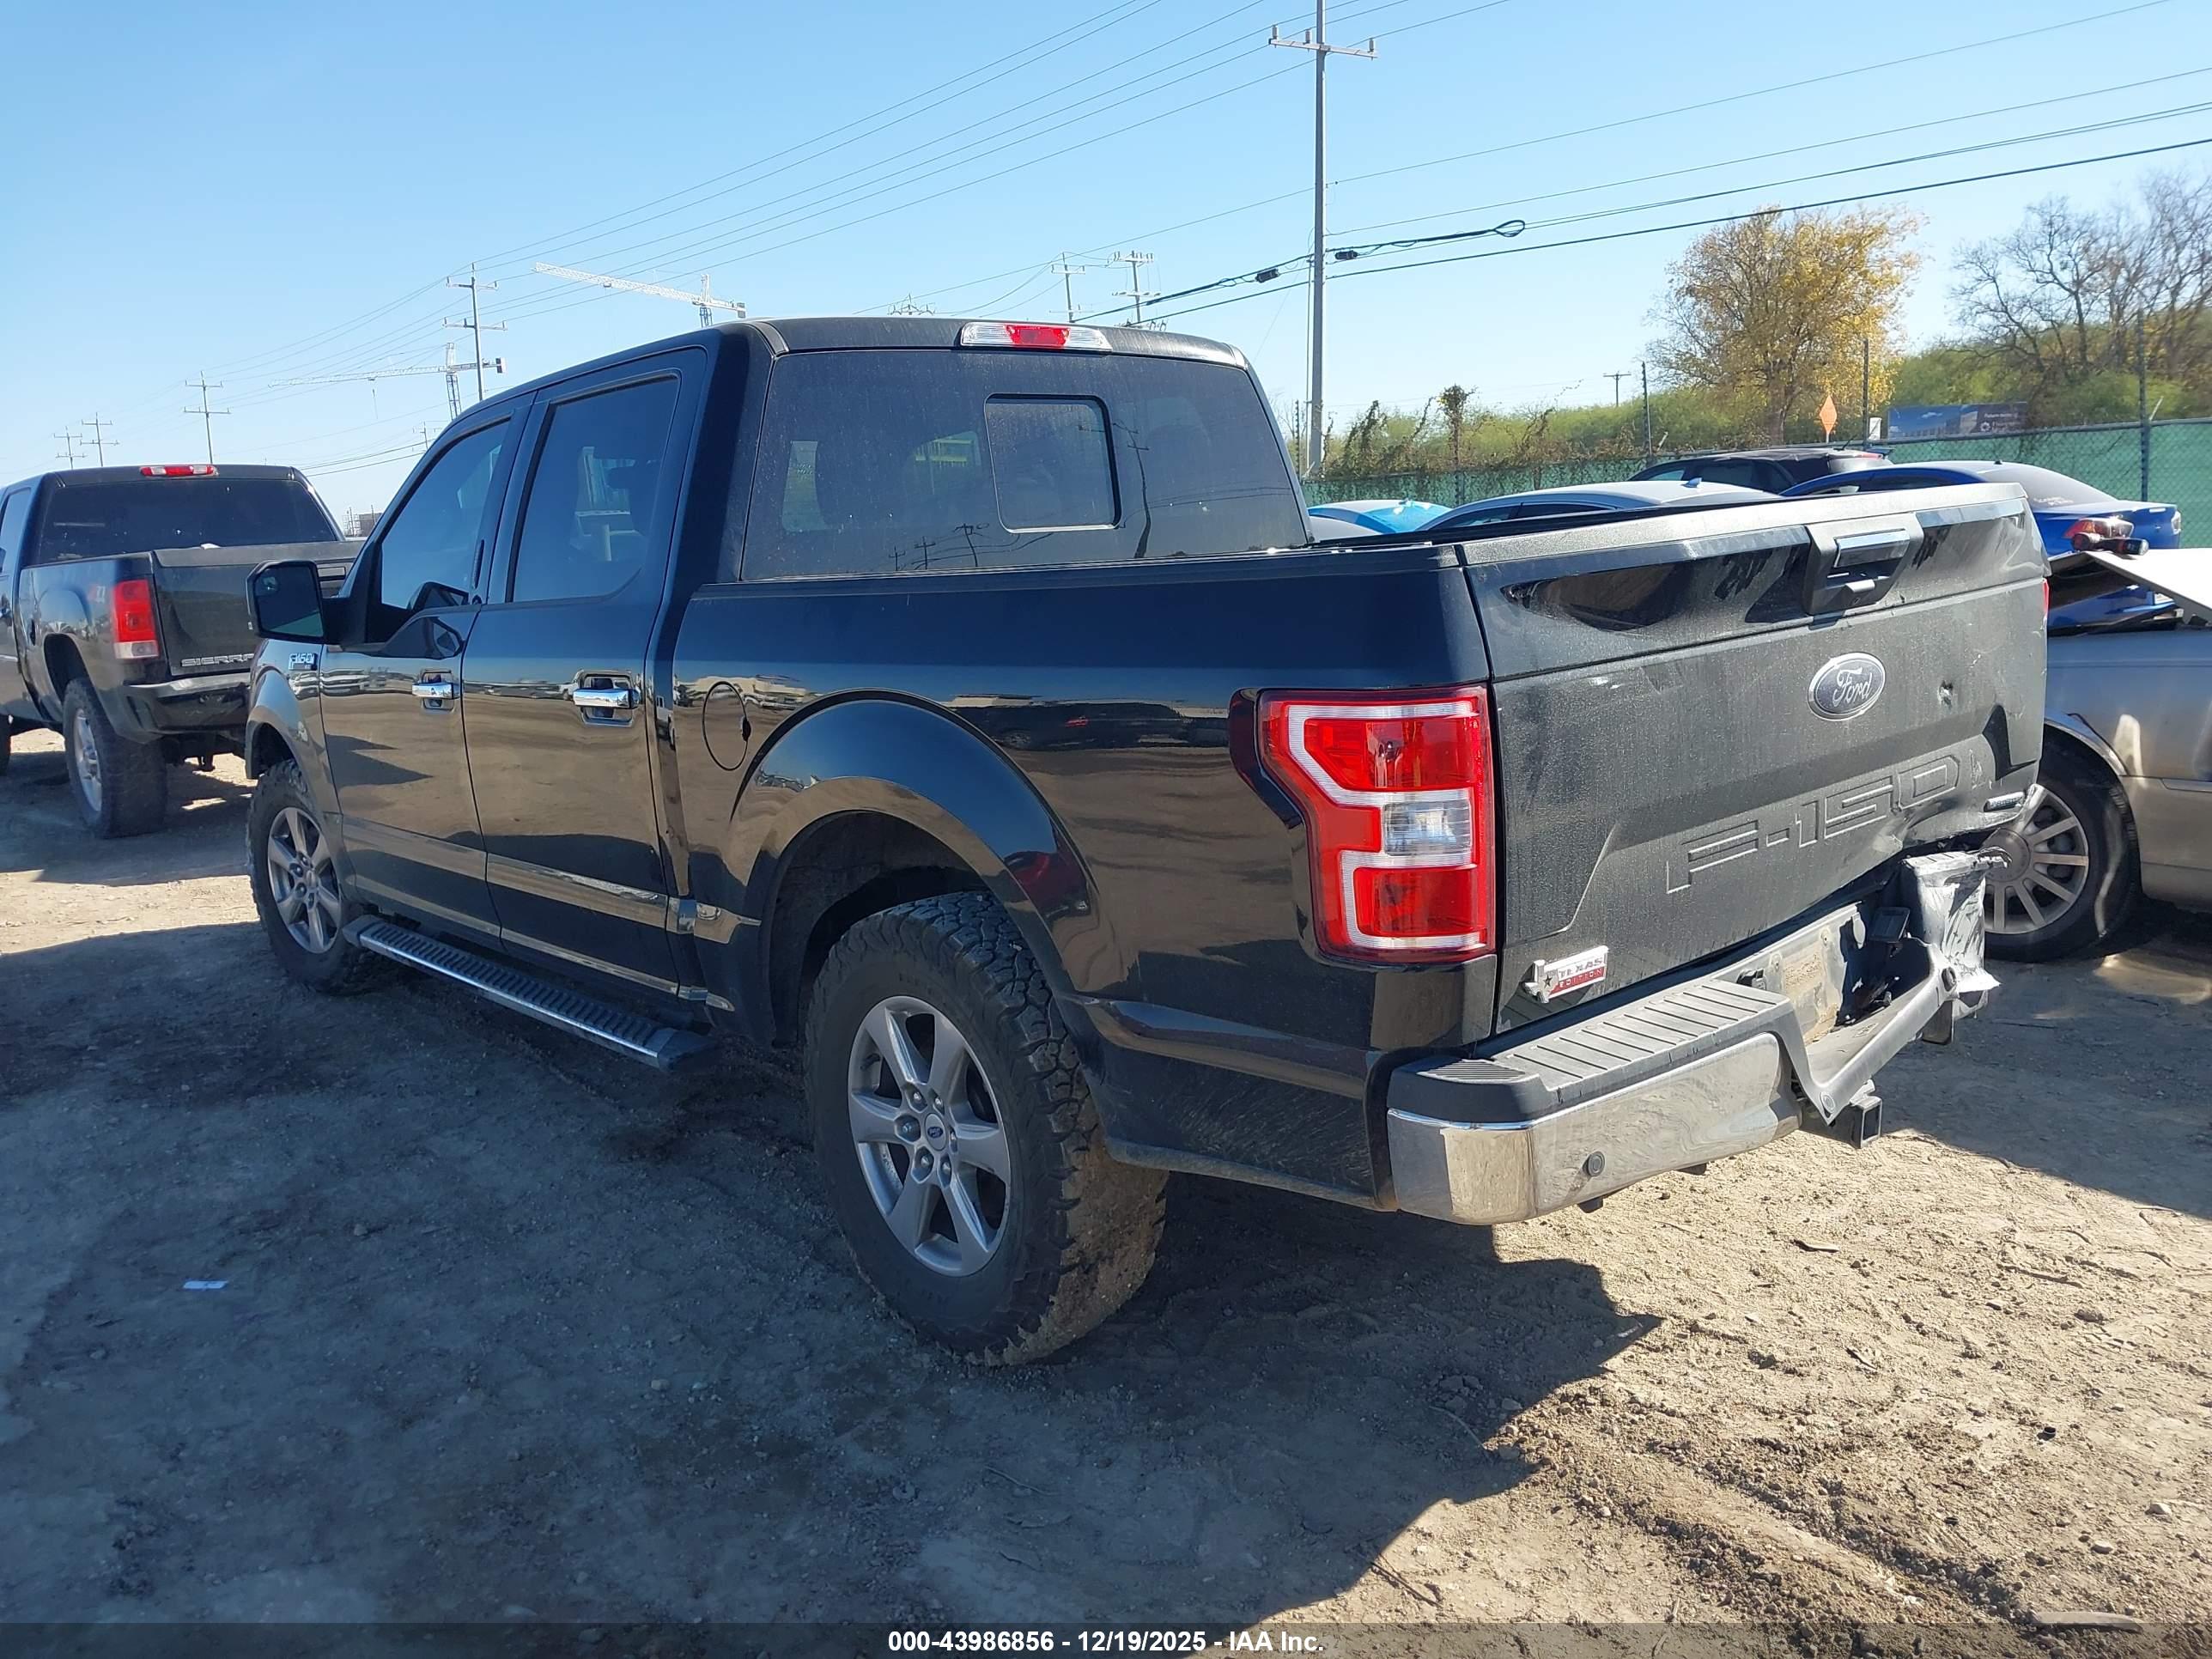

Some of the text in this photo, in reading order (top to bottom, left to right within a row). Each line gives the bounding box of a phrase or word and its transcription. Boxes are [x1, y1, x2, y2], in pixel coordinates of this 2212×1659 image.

[1832, 666, 1873, 708] Ford
[1666, 755, 1960, 894] F-150
[1559, 957, 1603, 977] TEXAS
[1559, 968, 1602, 988] EDITION
